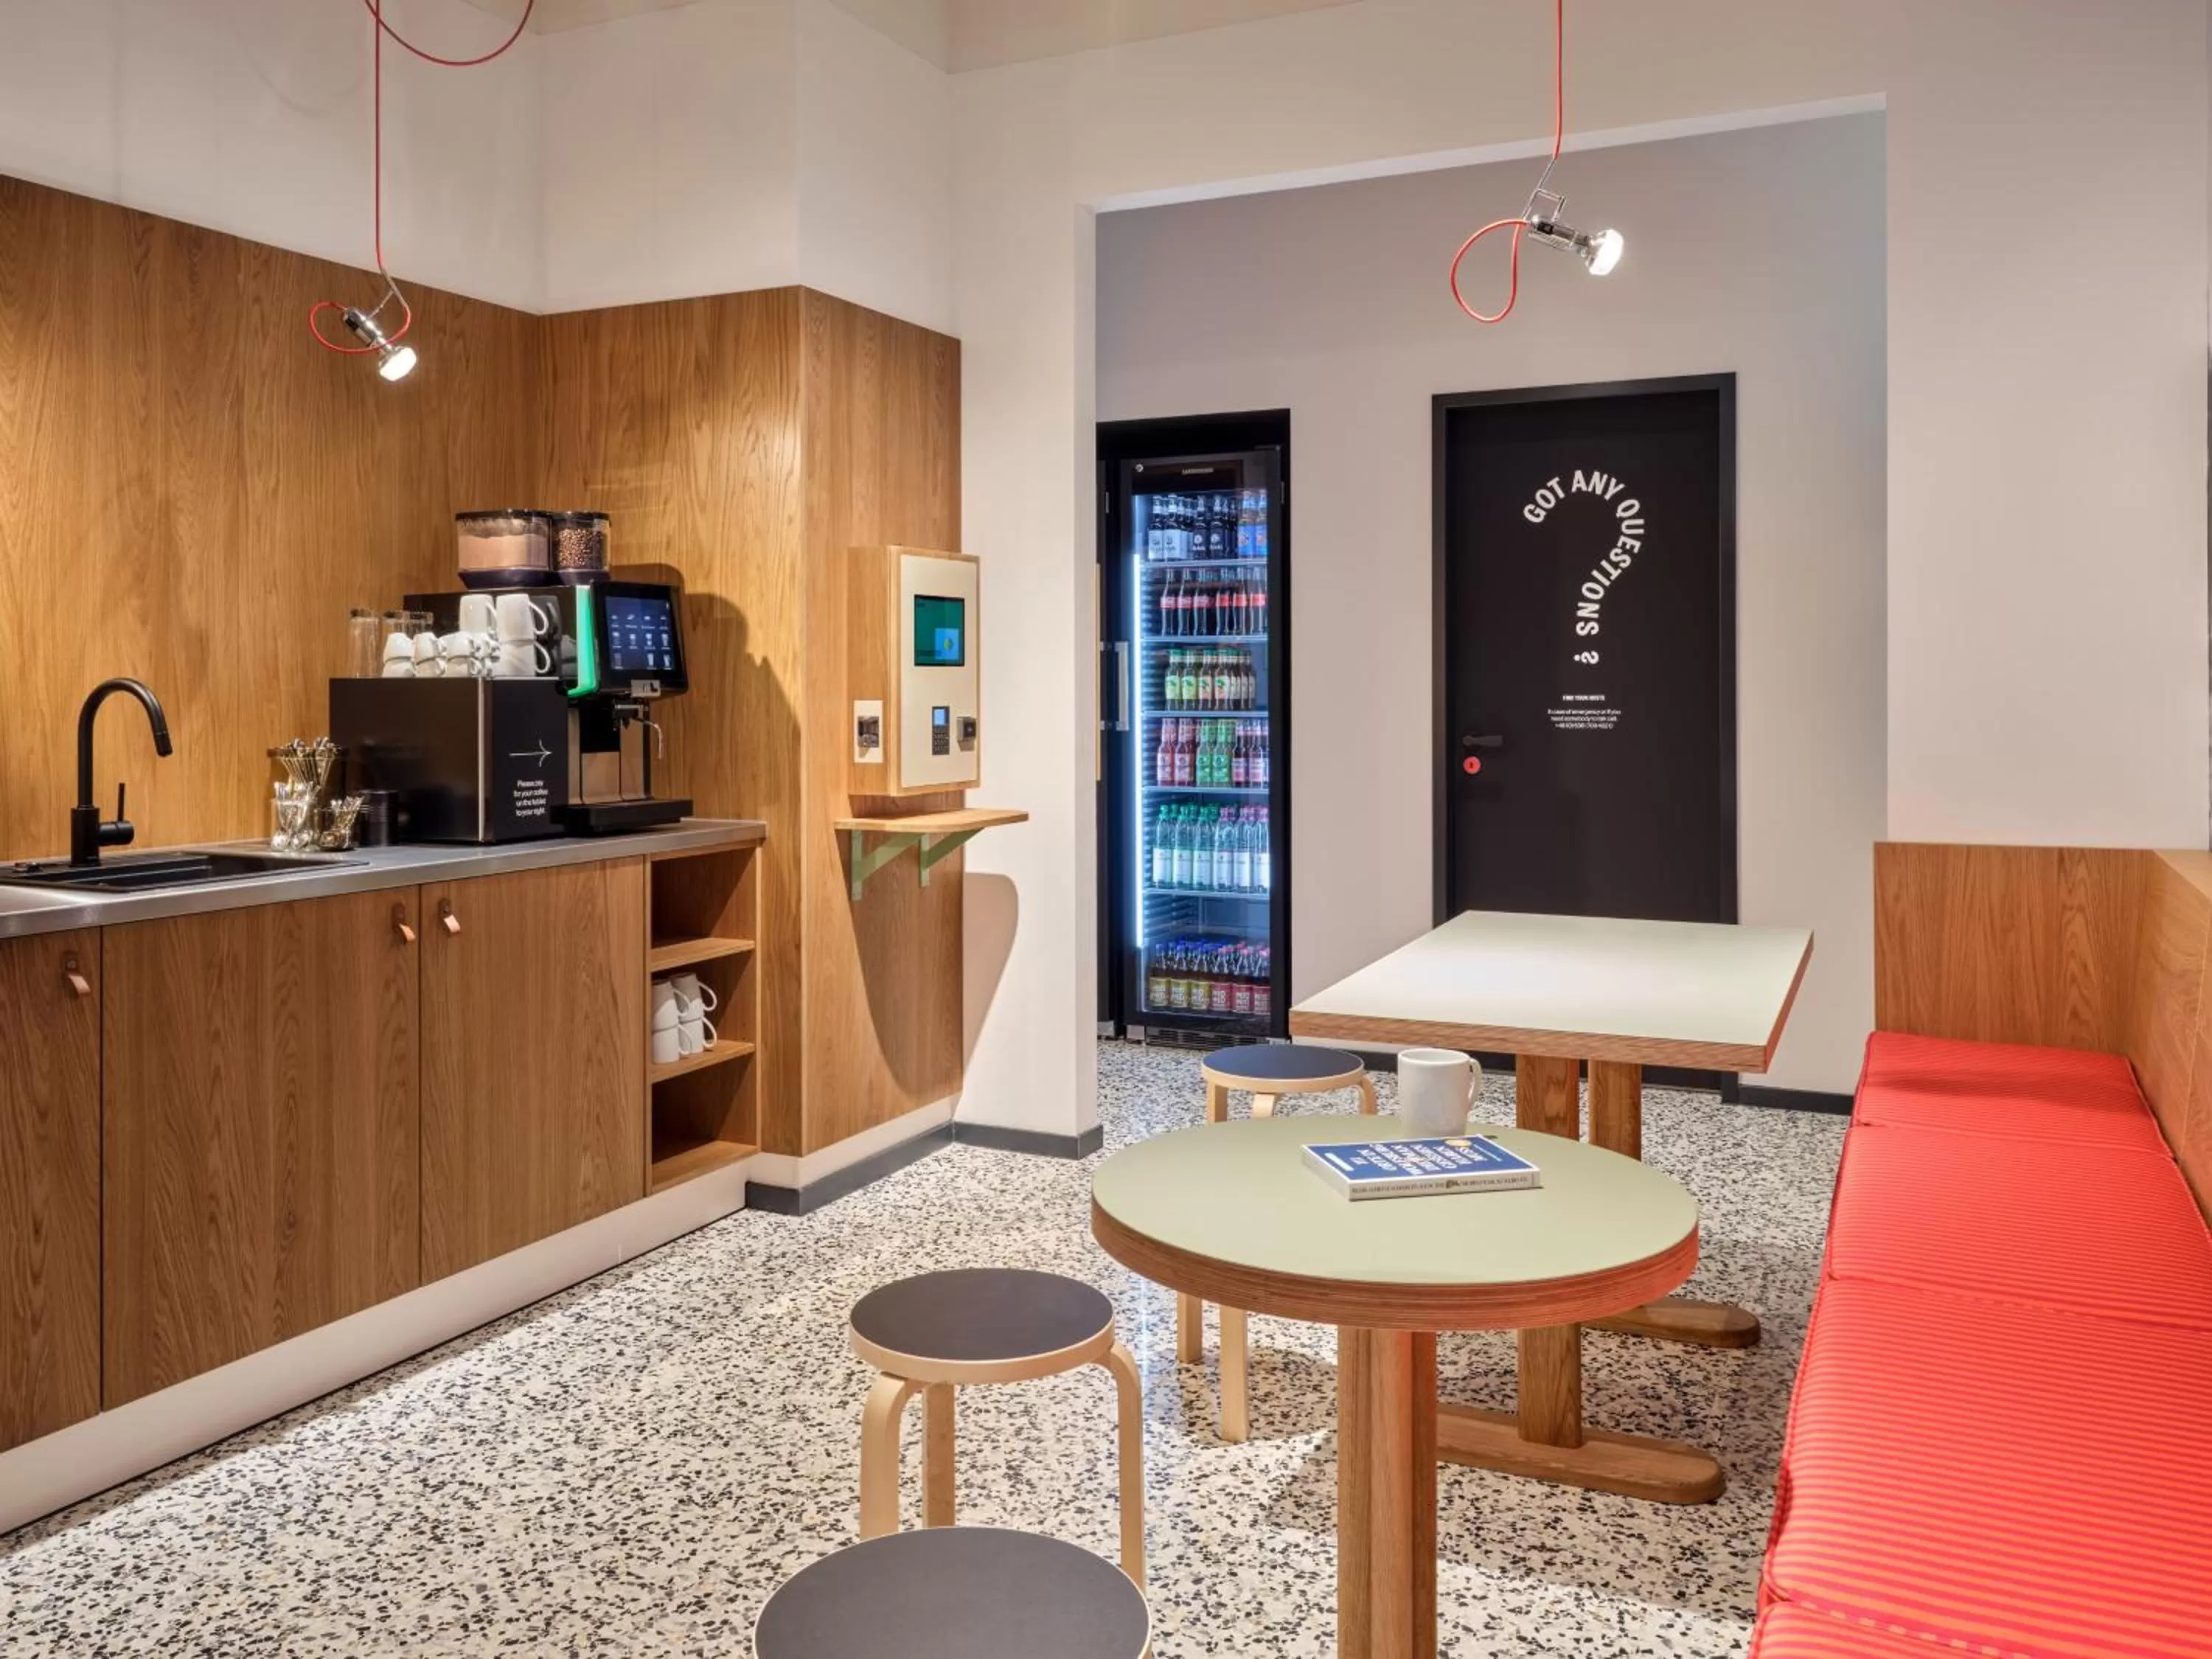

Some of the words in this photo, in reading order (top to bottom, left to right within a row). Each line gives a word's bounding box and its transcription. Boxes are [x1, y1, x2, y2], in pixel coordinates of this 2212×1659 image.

[1523, 476, 1565, 523] GOT
[1571, 470, 1626, 501] ANY
[1576, 498, 1645, 636] QUESTIONS
